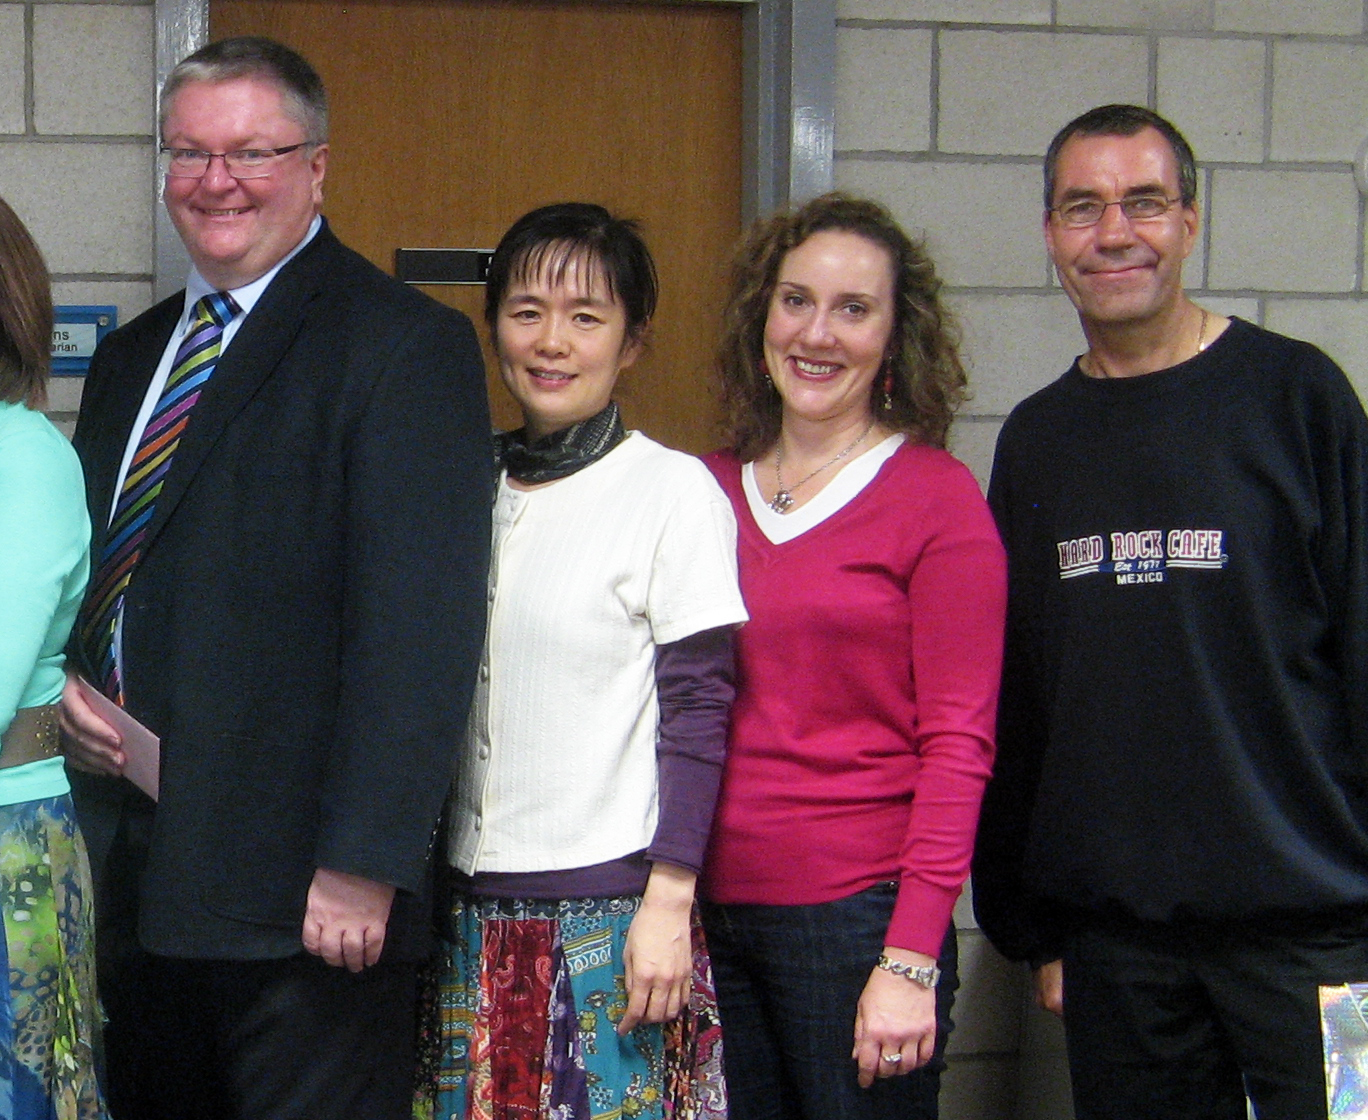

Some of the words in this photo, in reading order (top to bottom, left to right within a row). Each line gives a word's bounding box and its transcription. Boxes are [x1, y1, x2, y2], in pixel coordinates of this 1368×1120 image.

[53, 331, 69, 340] ns
[1057, 535, 1103, 569] HARD
[1111, 530, 1163, 561] ROCK
[1167, 529, 1222, 559] CAFE
[1116, 572, 1163, 585] MEXICO
